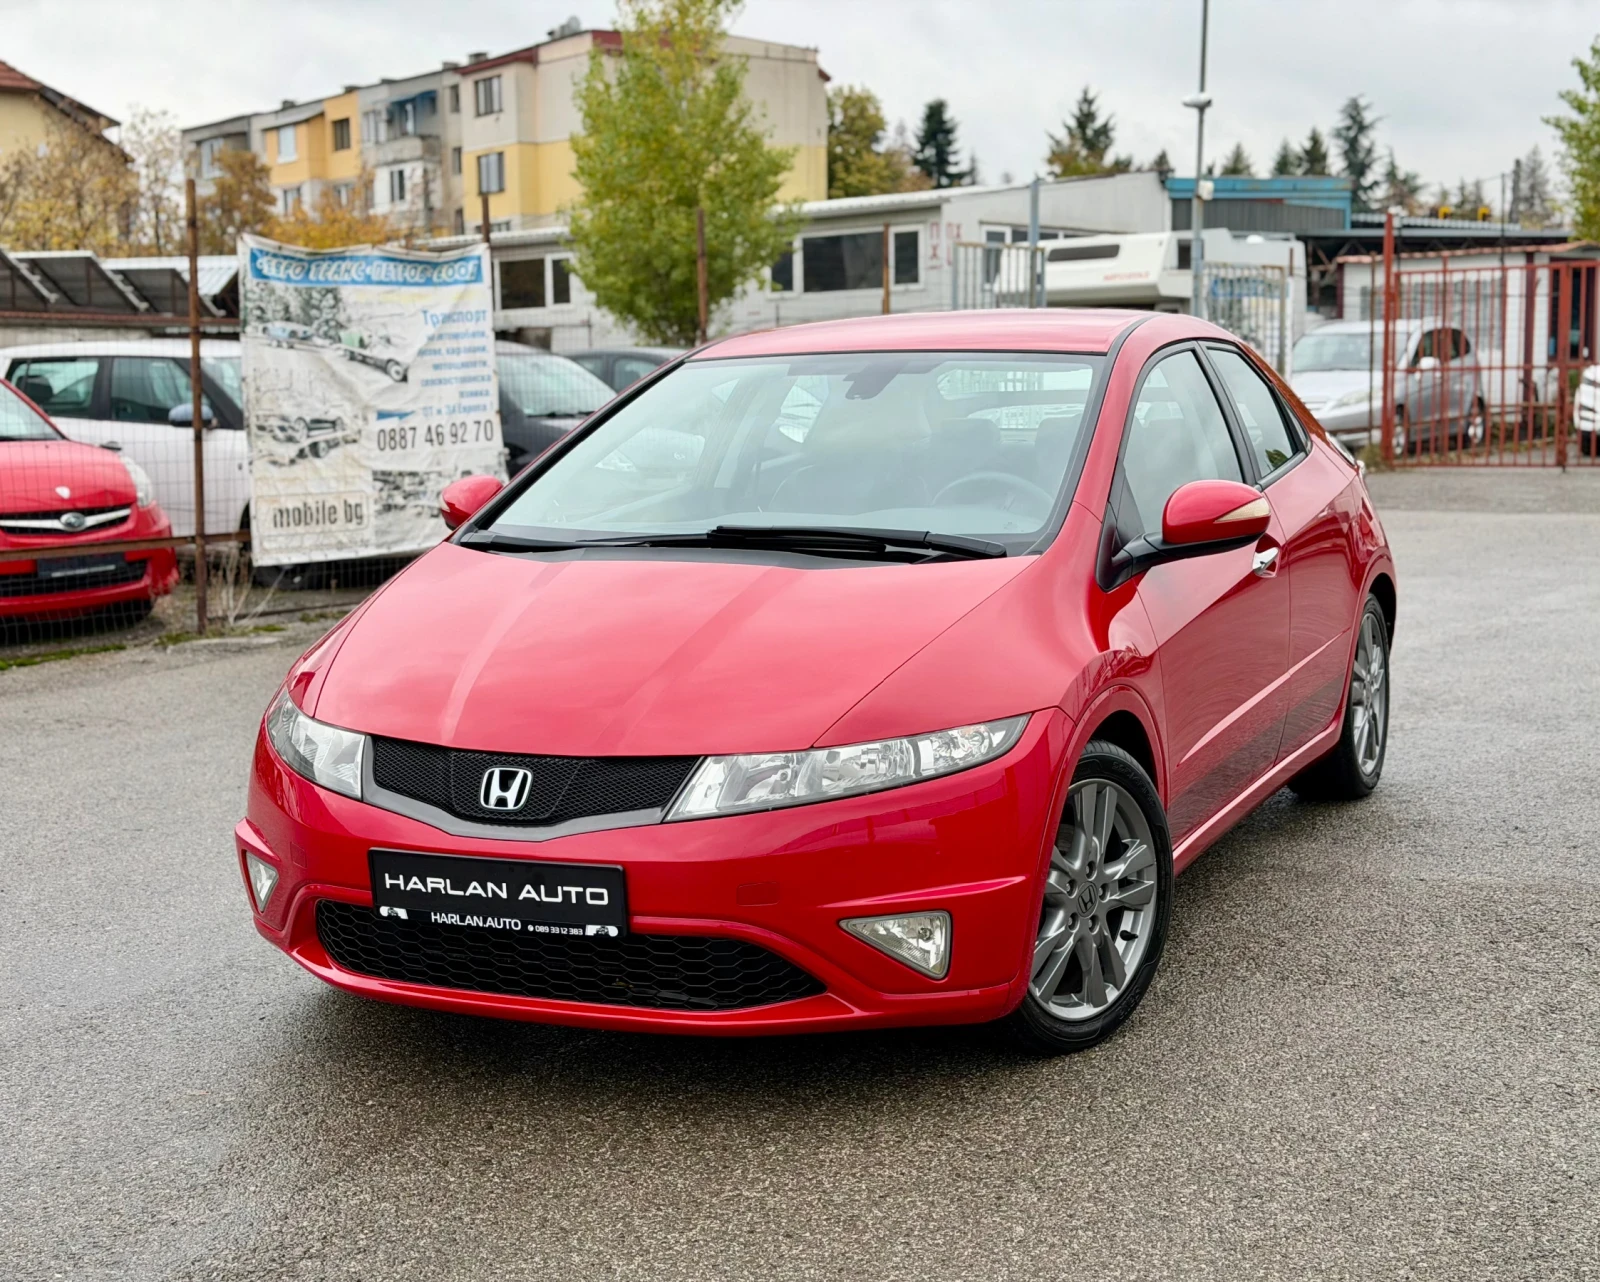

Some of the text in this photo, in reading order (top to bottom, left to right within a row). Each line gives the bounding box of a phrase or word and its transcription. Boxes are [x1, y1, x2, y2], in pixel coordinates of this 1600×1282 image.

[377, 419, 494, 451] 0887 46 92 70
[273, 501, 338, 528] mobile
[384, 873, 609, 905] HARLAN AUTO
[431, 912, 522, 931] HARLAN.AUTO
[550, 926, 560, 934] 33
[569, 927, 583, 935] 383
